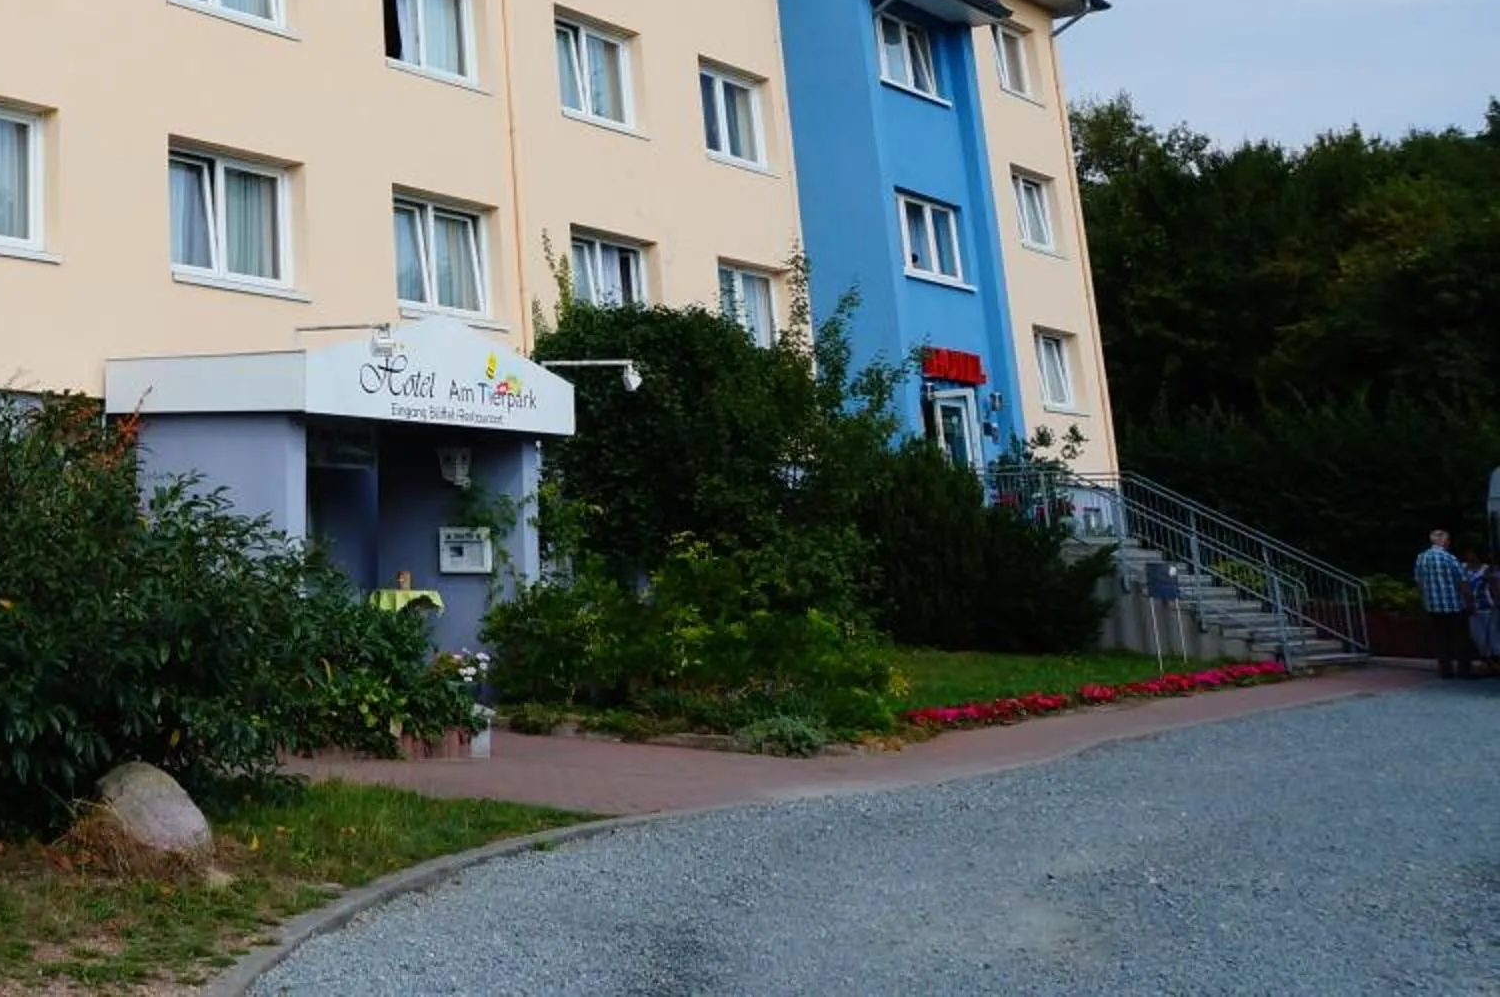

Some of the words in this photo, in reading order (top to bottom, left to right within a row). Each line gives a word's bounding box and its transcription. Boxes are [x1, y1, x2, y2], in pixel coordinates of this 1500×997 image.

[360, 354, 435, 399] Hotel
[450, 379, 475, 403] Am
[478, 382, 537, 412] Tierpark
